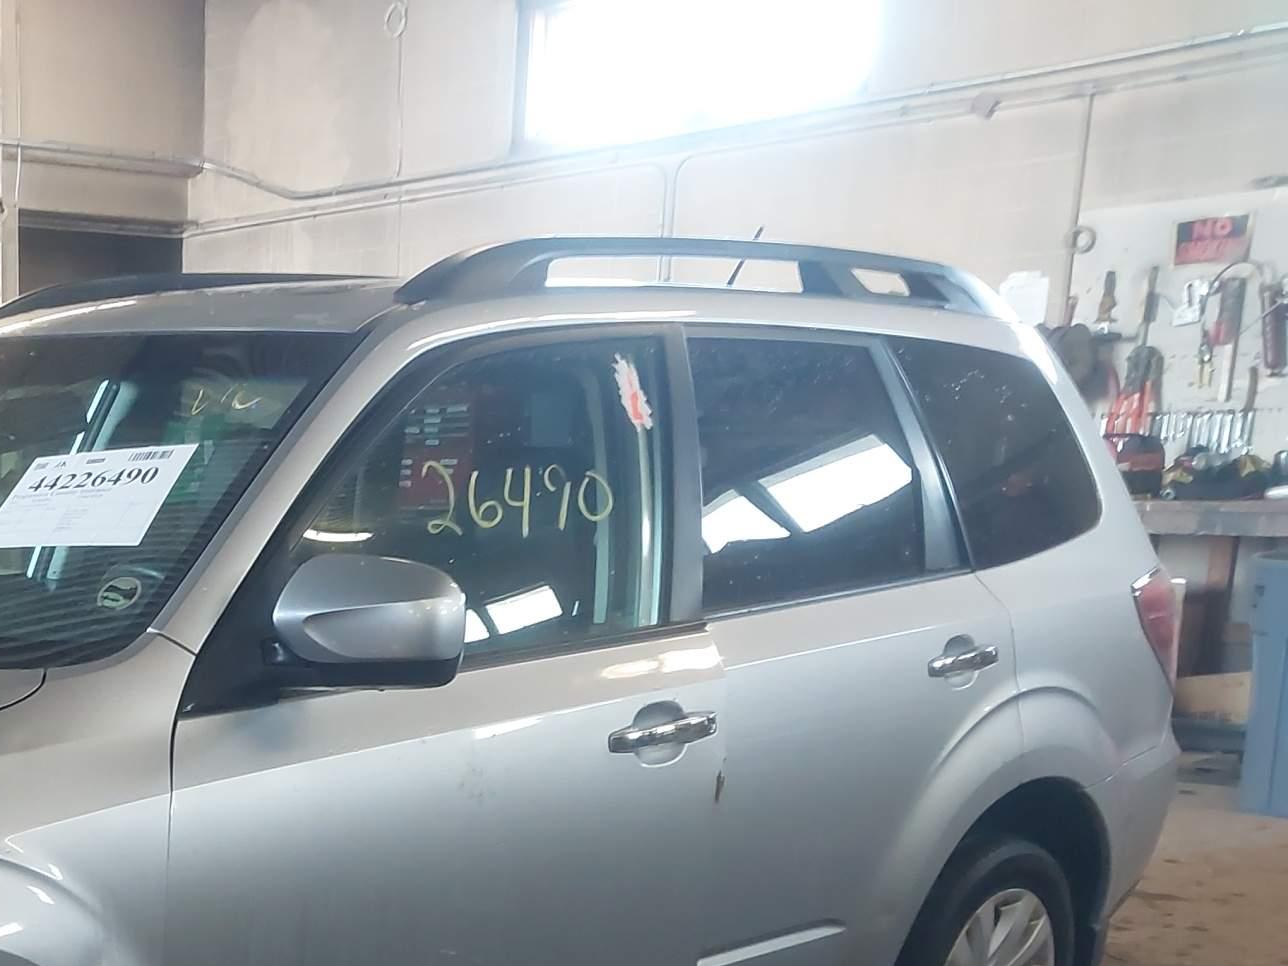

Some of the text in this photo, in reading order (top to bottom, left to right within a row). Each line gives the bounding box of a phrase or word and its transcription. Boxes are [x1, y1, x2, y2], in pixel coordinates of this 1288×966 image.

[1191, 217, 1234, 240] NO
[27, 466, 160, 493] 44226490
[421, 459, 615, 539] 26490
